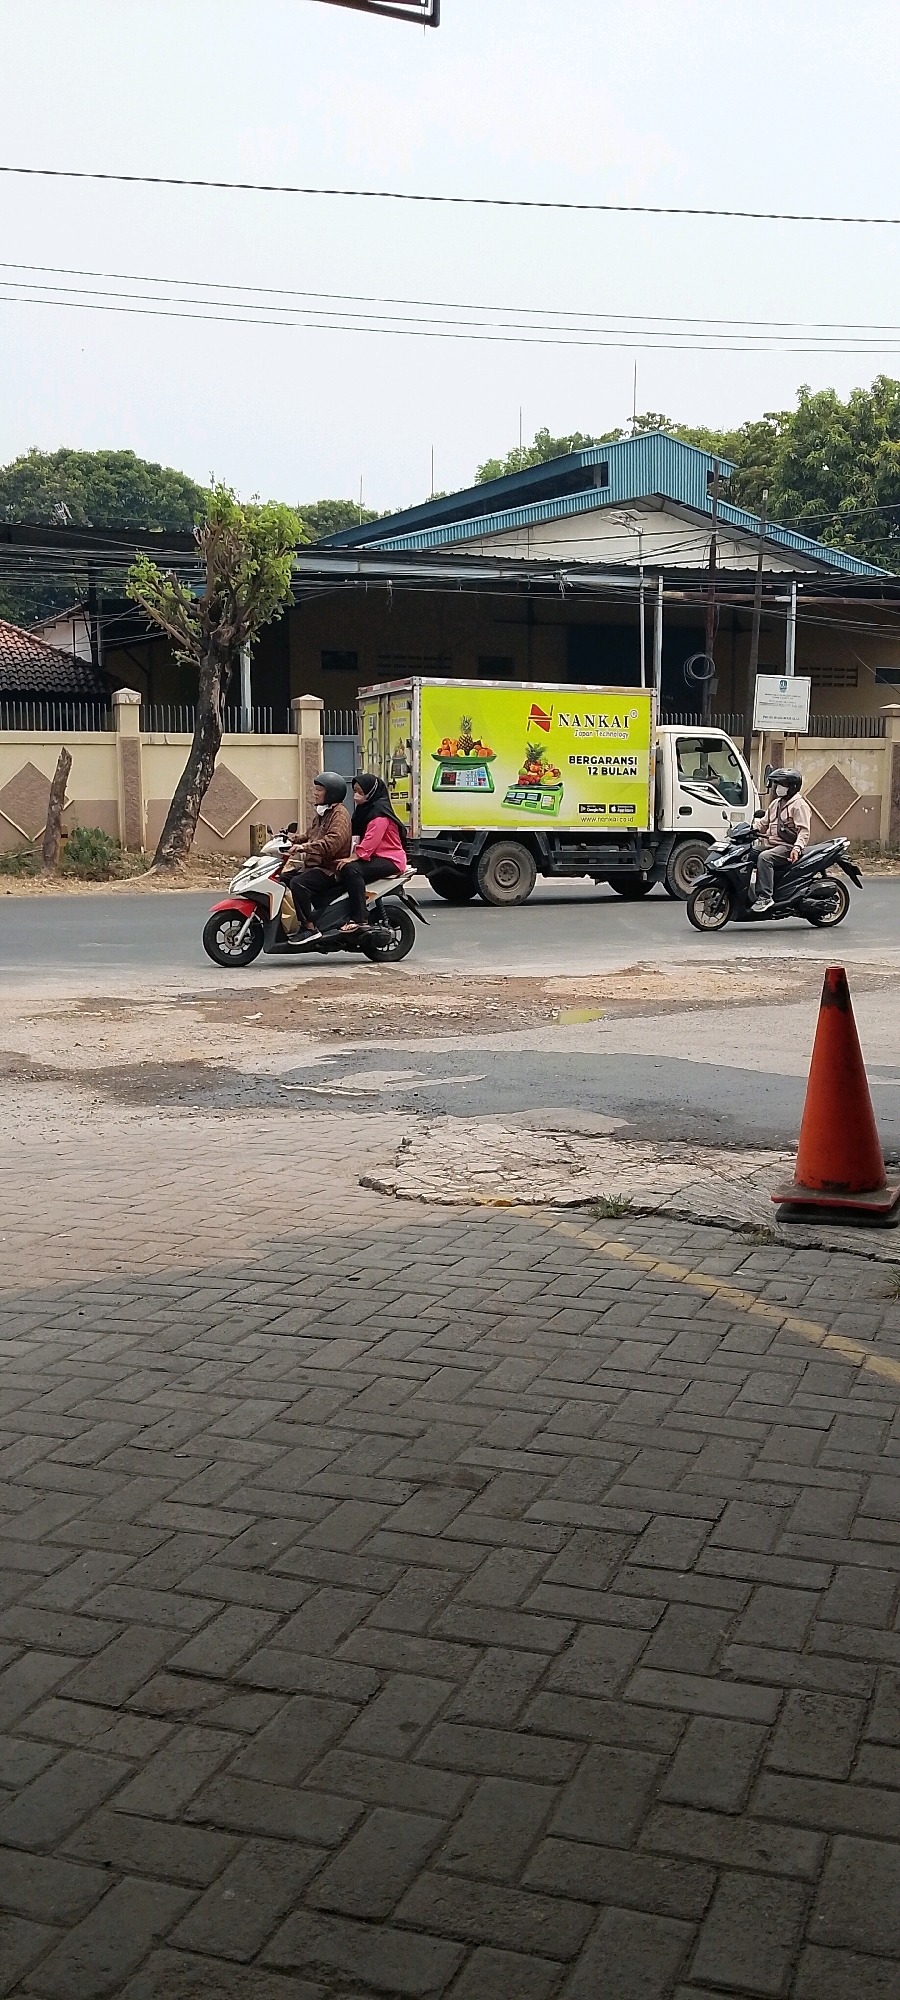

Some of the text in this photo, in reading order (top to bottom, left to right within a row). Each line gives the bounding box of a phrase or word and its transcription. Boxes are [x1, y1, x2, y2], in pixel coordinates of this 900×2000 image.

[558, 713, 630, 729] NANKAI
[574, 730, 629, 739] Japan Technology
[569, 756, 638, 766] BERGARANSI
[587, 766, 637, 776] 12 BULAN
